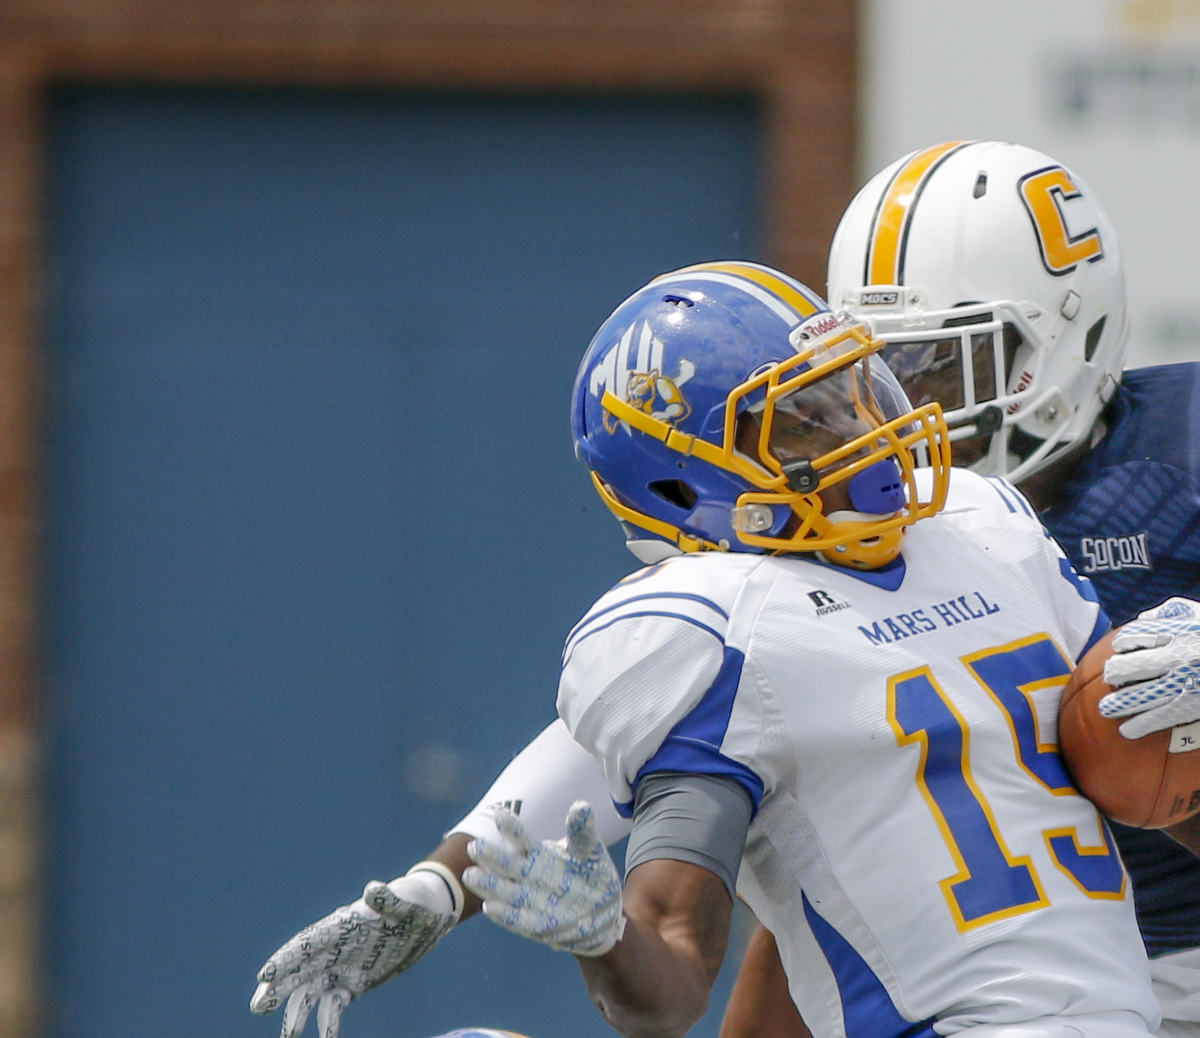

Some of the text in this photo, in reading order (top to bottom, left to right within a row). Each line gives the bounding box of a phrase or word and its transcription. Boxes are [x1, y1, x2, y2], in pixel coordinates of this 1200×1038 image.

[1016, 165, 1104, 277] C
[861, 292, 899, 306] MOCS
[857, 591, 1001, 646] MARS HILL
[885, 631, 1128, 935] 15
